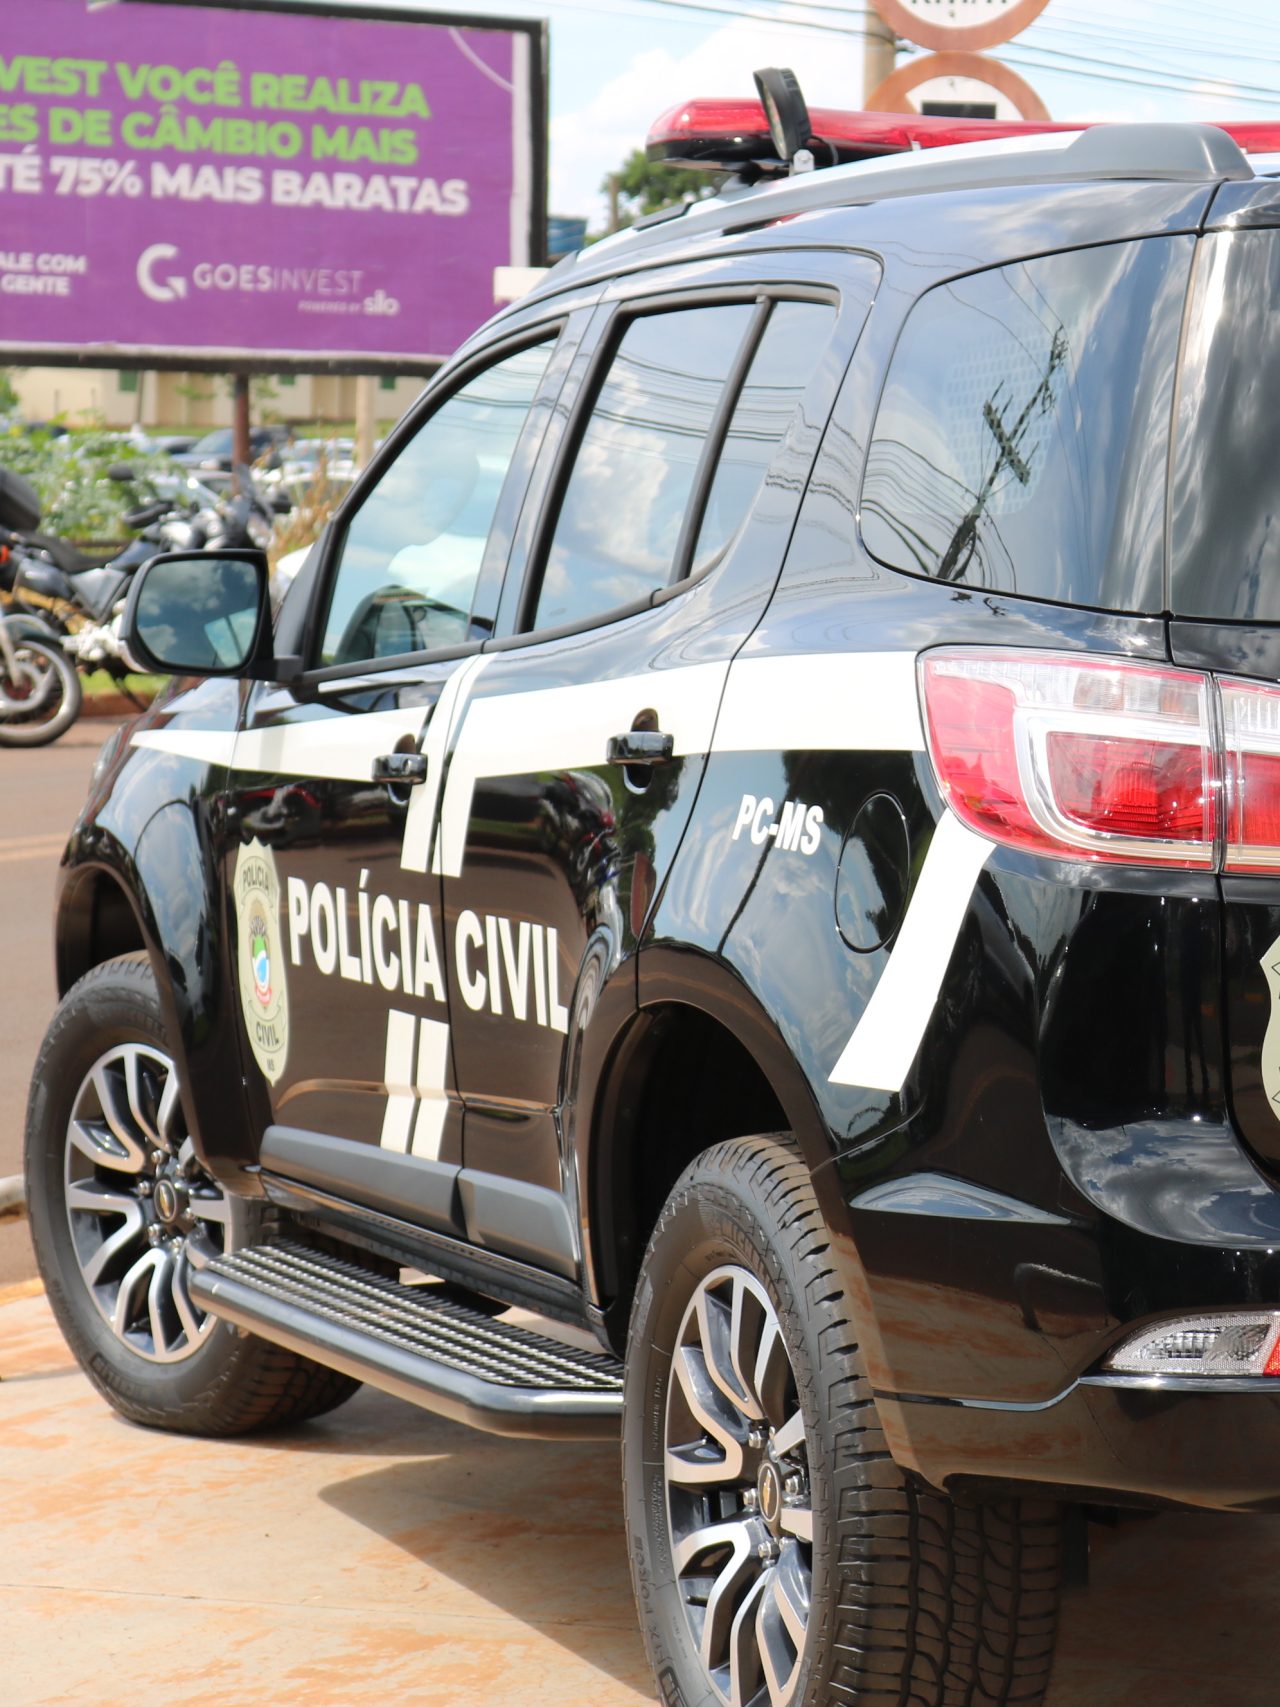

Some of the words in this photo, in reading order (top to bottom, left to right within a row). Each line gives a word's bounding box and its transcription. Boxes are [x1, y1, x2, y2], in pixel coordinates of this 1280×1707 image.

[115, 61, 242, 107] VOCÊ
[250, 73, 430, 119] REALIZA
[49, 106, 112, 147] DE
[121, 105, 303, 159] CÂMBIO
[312, 124, 419, 165] MAIS
[49, 155, 141, 198] 75%
[150, 161, 263, 205] MAIS
[271, 173, 470, 216] BARATAS
[1, 273, 71, 296] GENTE
[36, 253, 87, 275] COM
[732, 794, 824, 856] PC-MS
[287, 868, 446, 1004] POLÍCIA
[455, 909, 569, 1034] CIVIL
[256, 1020, 280, 1047] CIVIL
